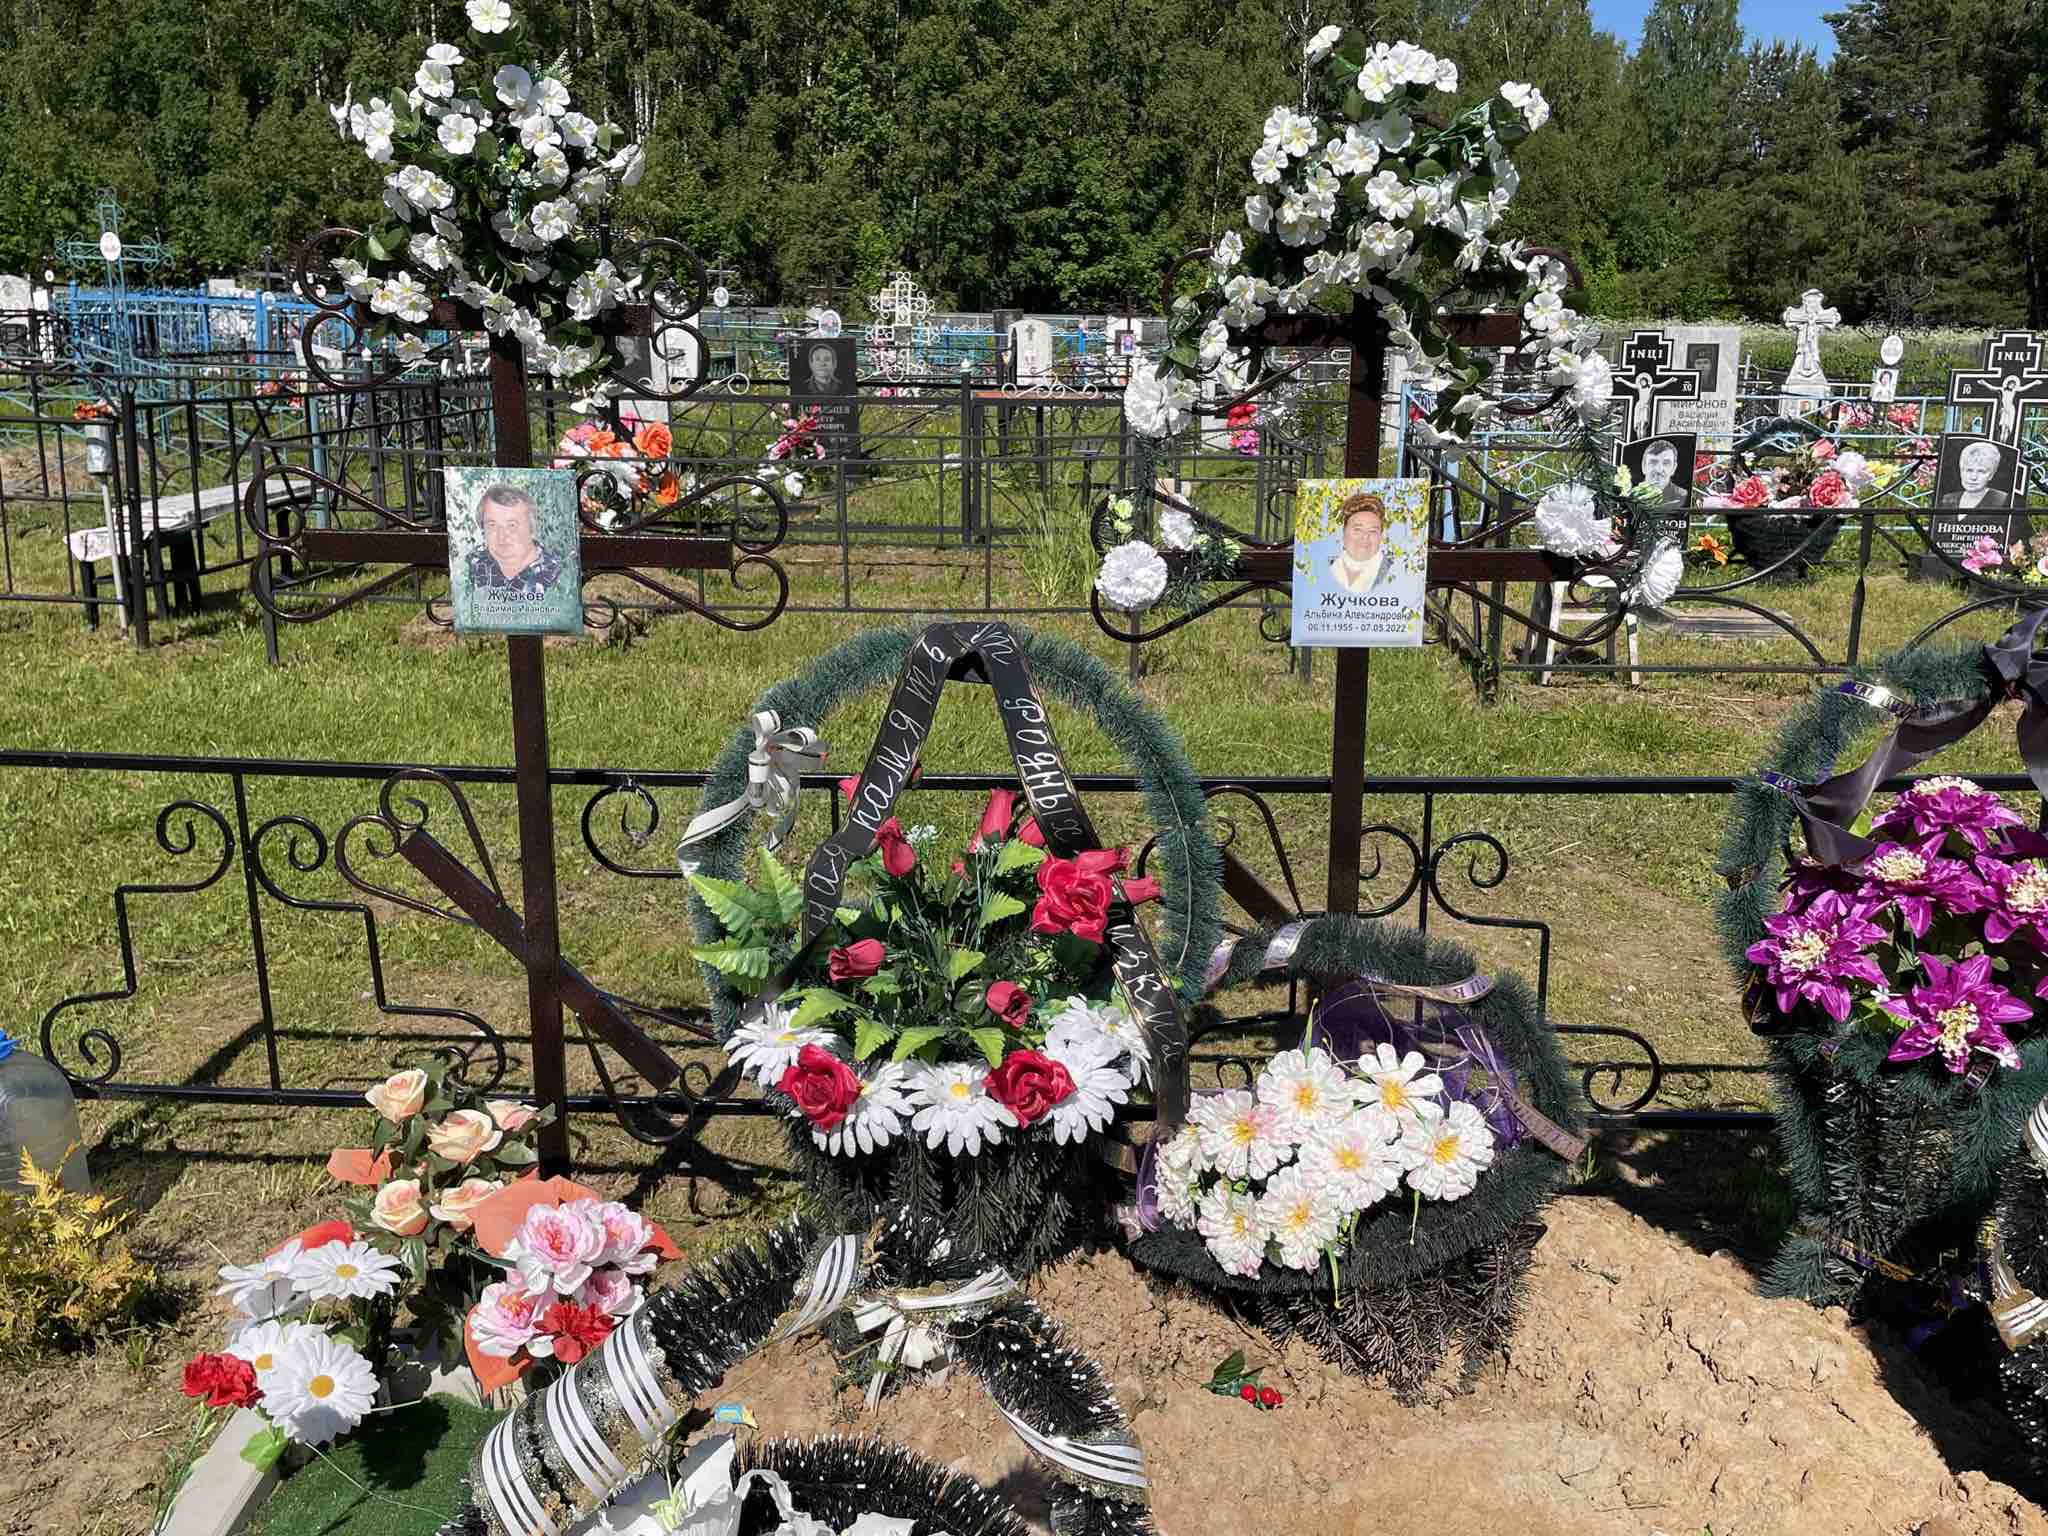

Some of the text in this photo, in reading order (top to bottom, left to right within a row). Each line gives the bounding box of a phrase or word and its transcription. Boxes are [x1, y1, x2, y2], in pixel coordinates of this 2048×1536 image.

[1670, 399, 1729, 409] МИРОНОВ
[487, 589, 545, 602] Жучков
[1320, 592, 1400, 609] Жучкова
[1303, 609, 1412, 622] Альбина Александровна
